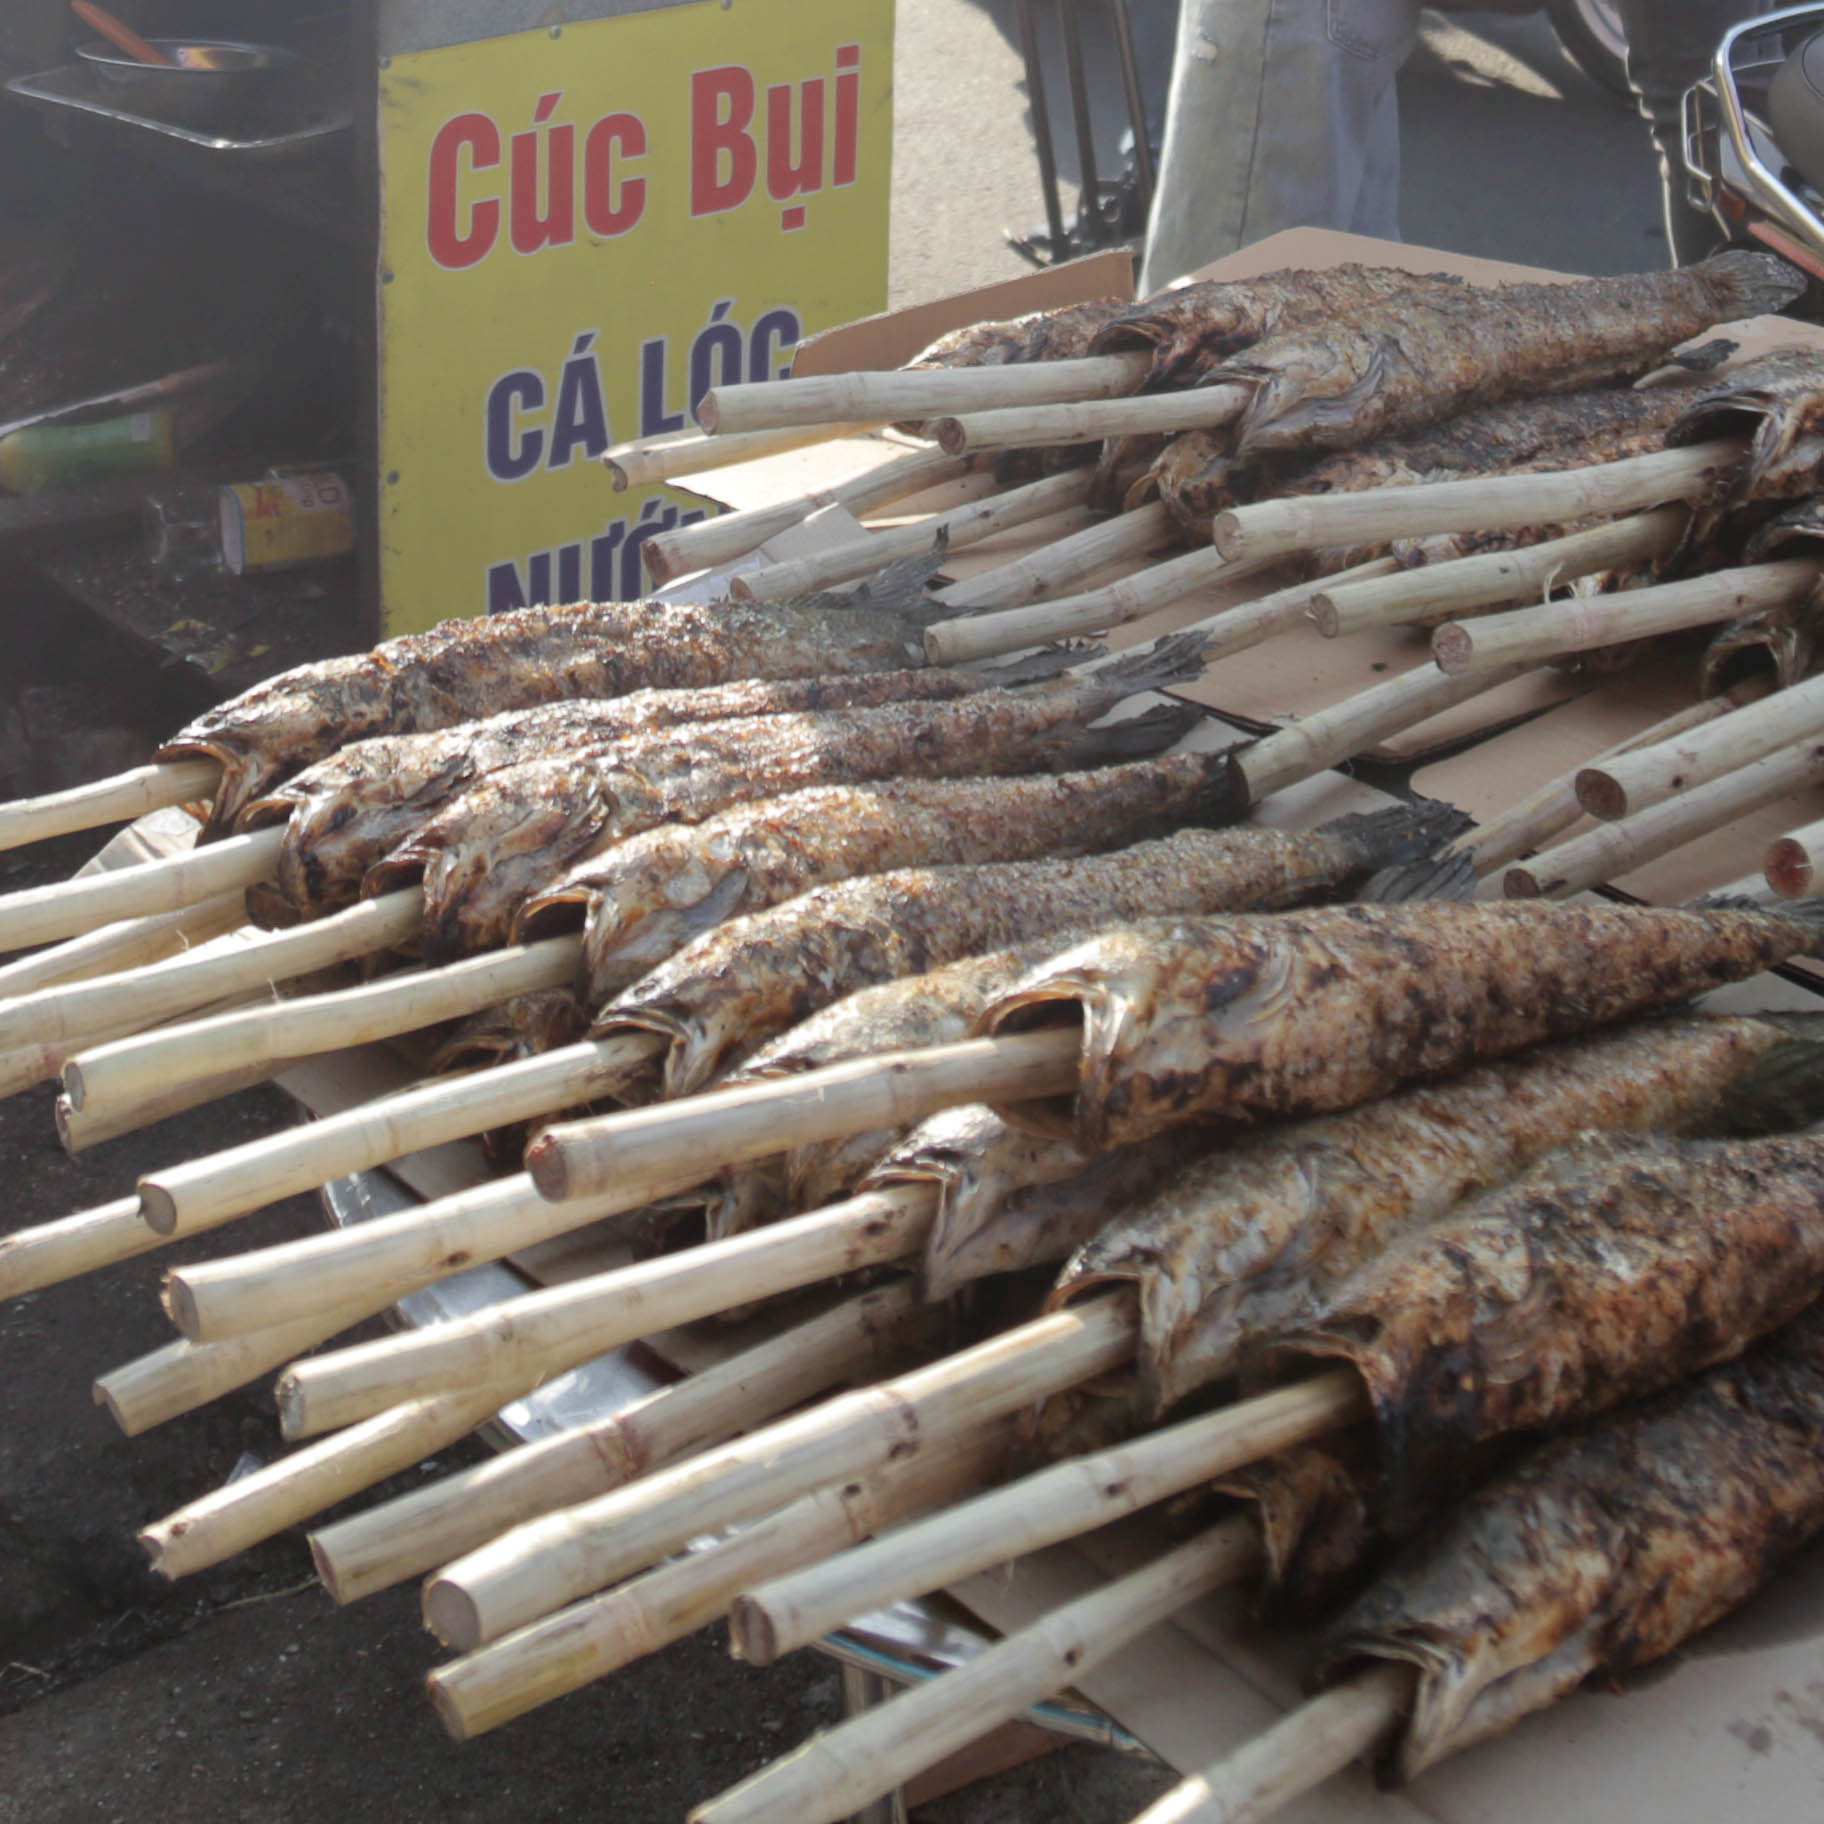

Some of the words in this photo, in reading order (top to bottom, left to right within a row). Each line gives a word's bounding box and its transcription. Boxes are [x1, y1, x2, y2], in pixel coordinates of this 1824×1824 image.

[426, 90, 648, 271] Cúc
[690, 42, 861, 233] Bụi
[486, 329, 609, 481] CÁ
[641, 299, 801, 439] LÓC
